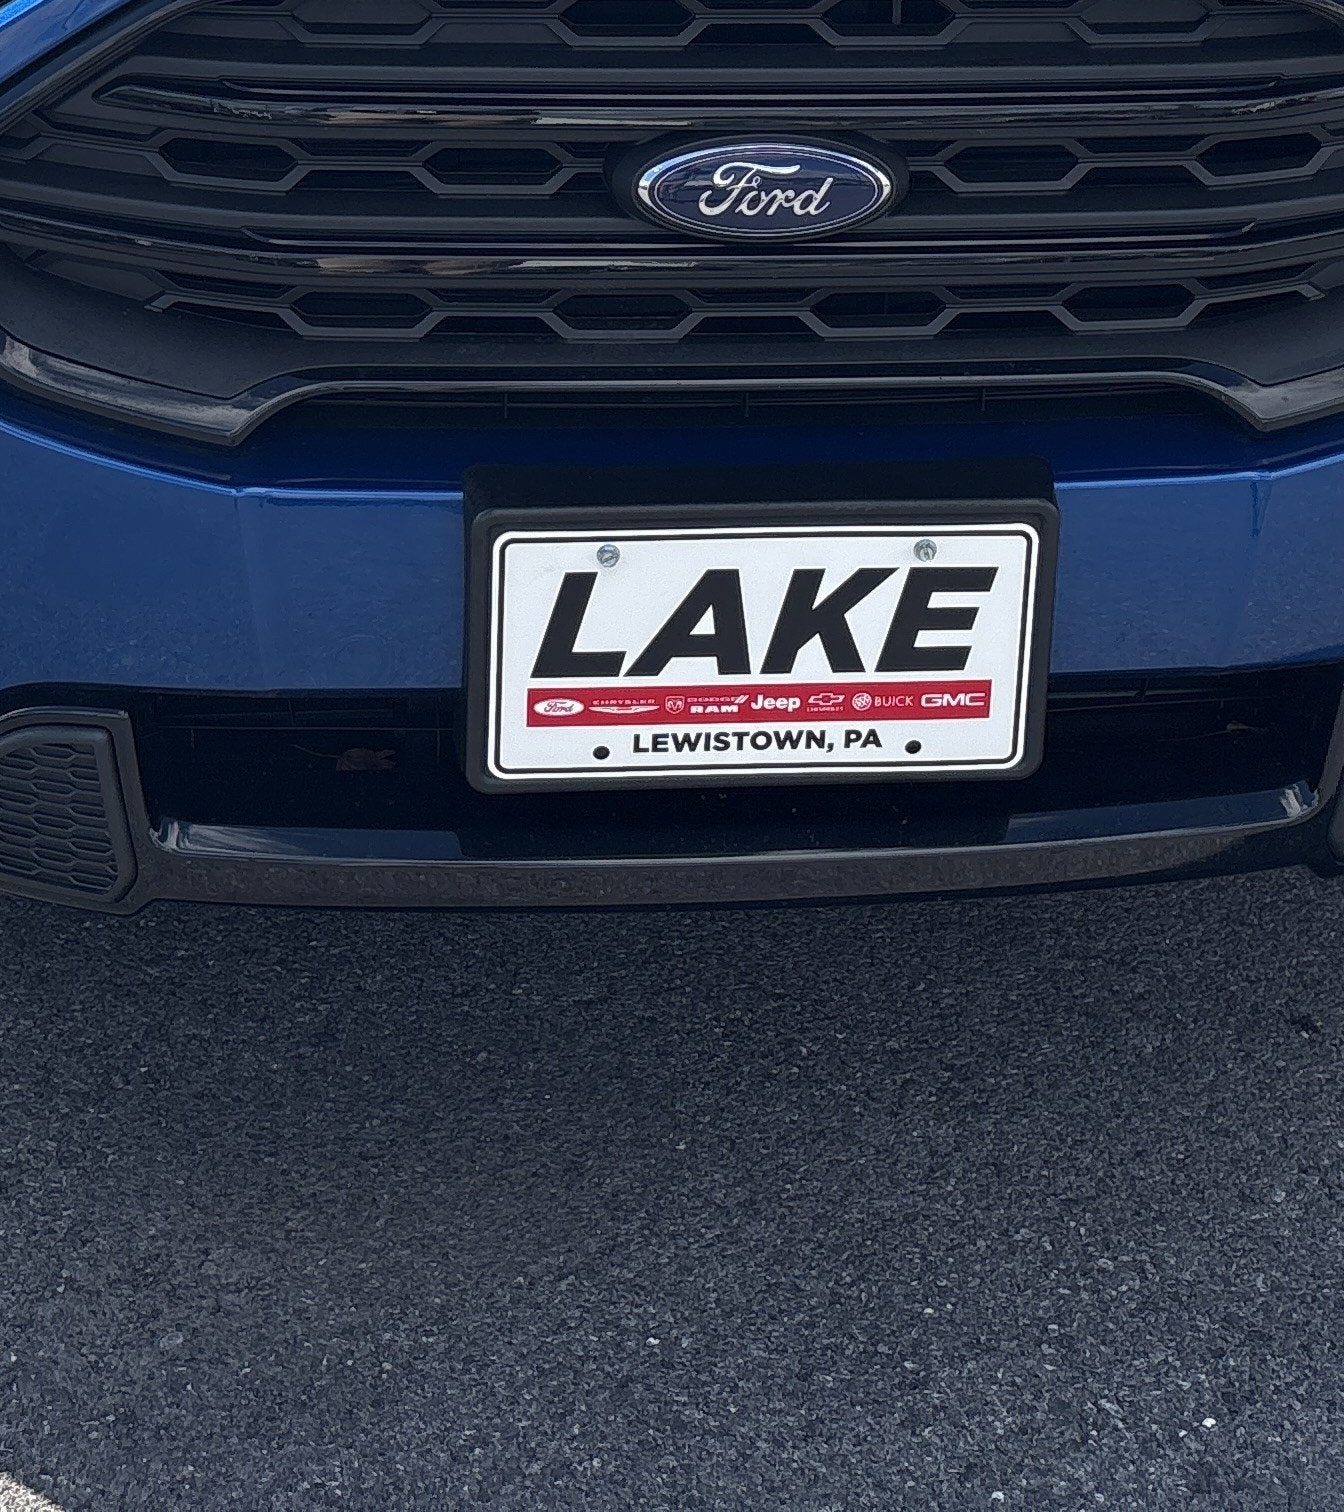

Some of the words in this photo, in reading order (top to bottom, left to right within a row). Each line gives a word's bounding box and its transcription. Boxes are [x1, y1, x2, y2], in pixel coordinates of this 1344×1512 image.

[698, 161, 834, 216] Ford
[530, 567, 999, 678] LAKE
[543, 700, 575, 714] Ford
[750, 694, 801, 713] Jeep
[874, 694, 914, 708] BUICK
[920, 692, 986, 708] GMC
[690, 704, 739, 714] RAM
[633, 729, 835, 754] LEWISTOWN,
[843, 728, 883, 749] PA
